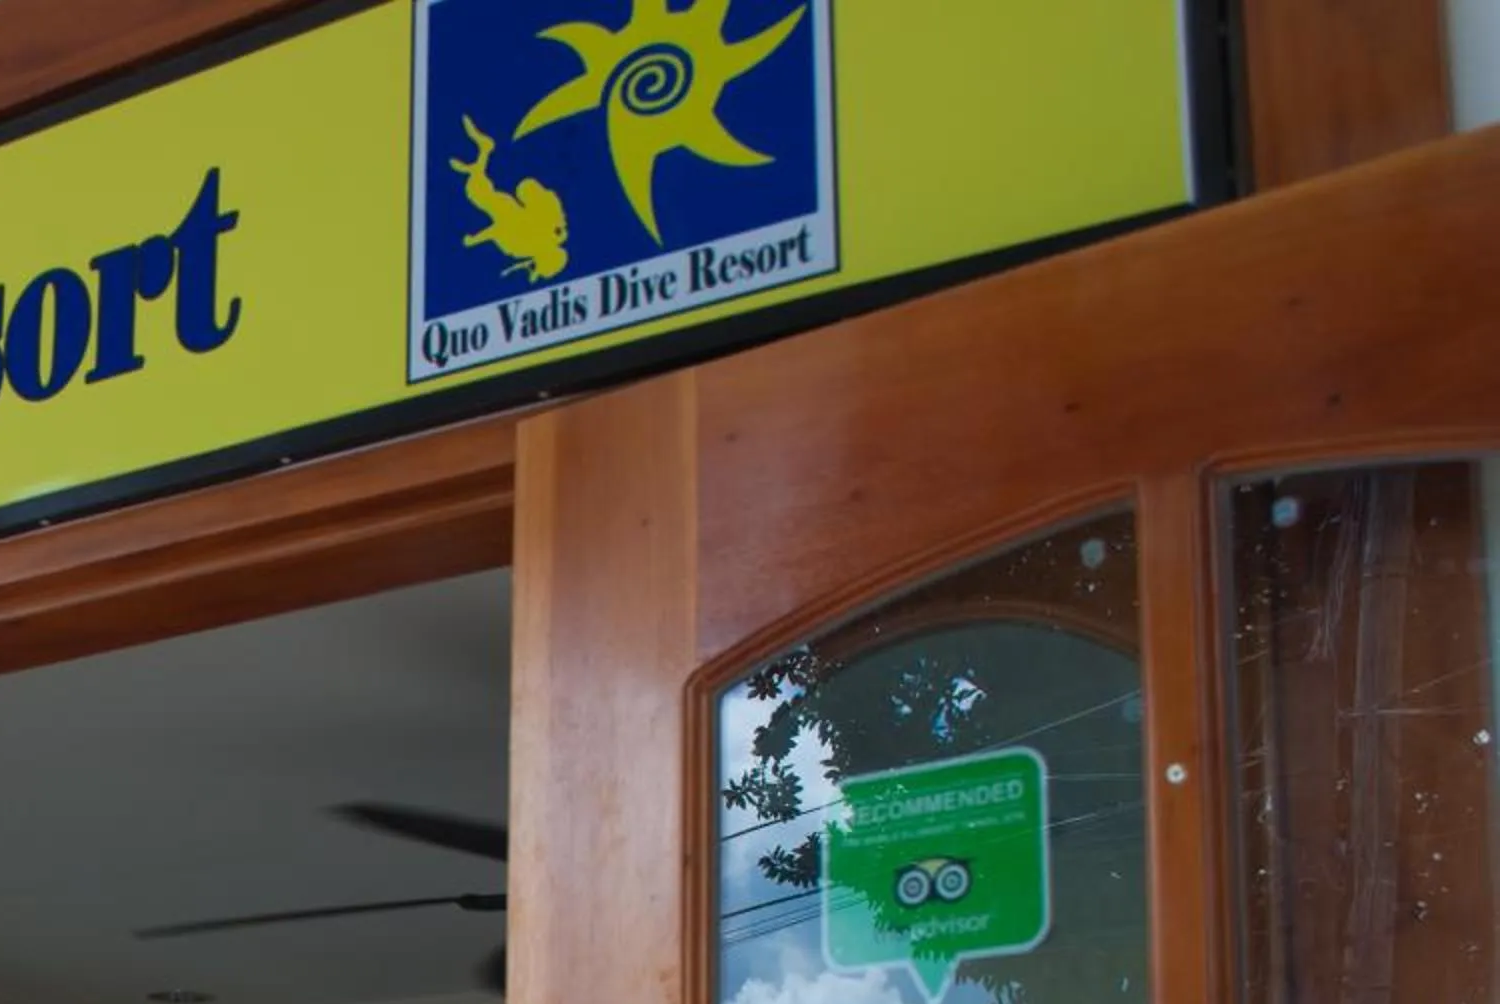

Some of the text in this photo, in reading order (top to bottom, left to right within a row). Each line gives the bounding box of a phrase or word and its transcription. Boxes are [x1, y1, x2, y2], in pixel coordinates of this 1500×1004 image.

[421, 223, 814, 368] Quo Vadis Dive Resort
